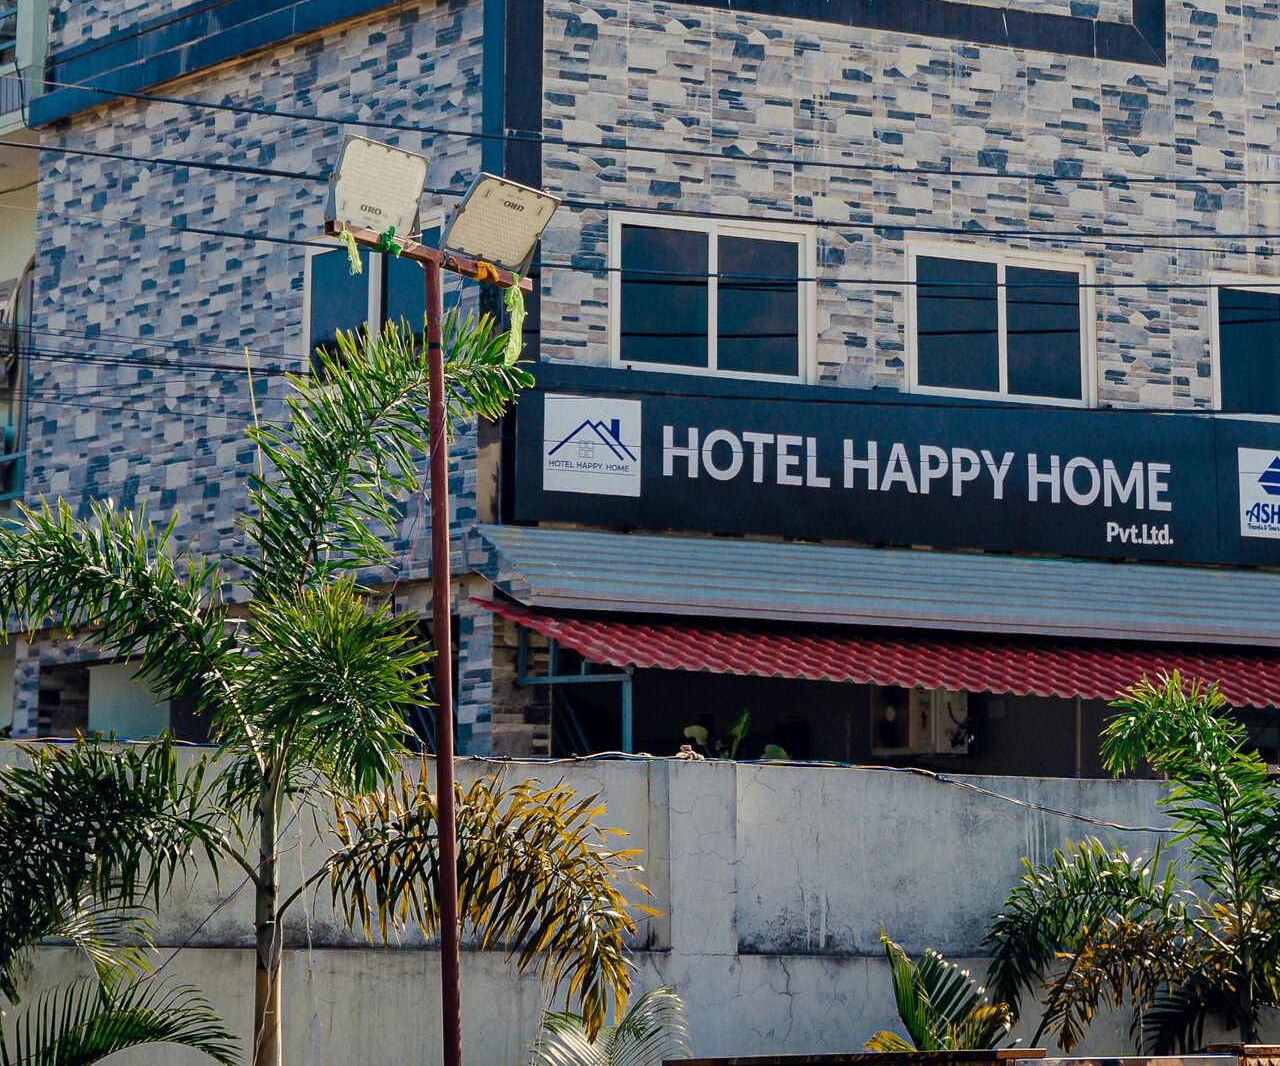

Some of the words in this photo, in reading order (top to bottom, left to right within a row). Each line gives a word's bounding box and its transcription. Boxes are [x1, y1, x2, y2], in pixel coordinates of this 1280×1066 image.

[548, 460, 574, 469] HOTEL
[576, 462, 604, 470] HAPPY
[605, 464, 630, 472] HOME
[663, 425, 831, 489] HOTEL
[843, 438, 1015, 500] HAPPY
[1027, 453, 1172, 512] HOME
[1106, 522, 1174, 545] Pvt.Ltd.
